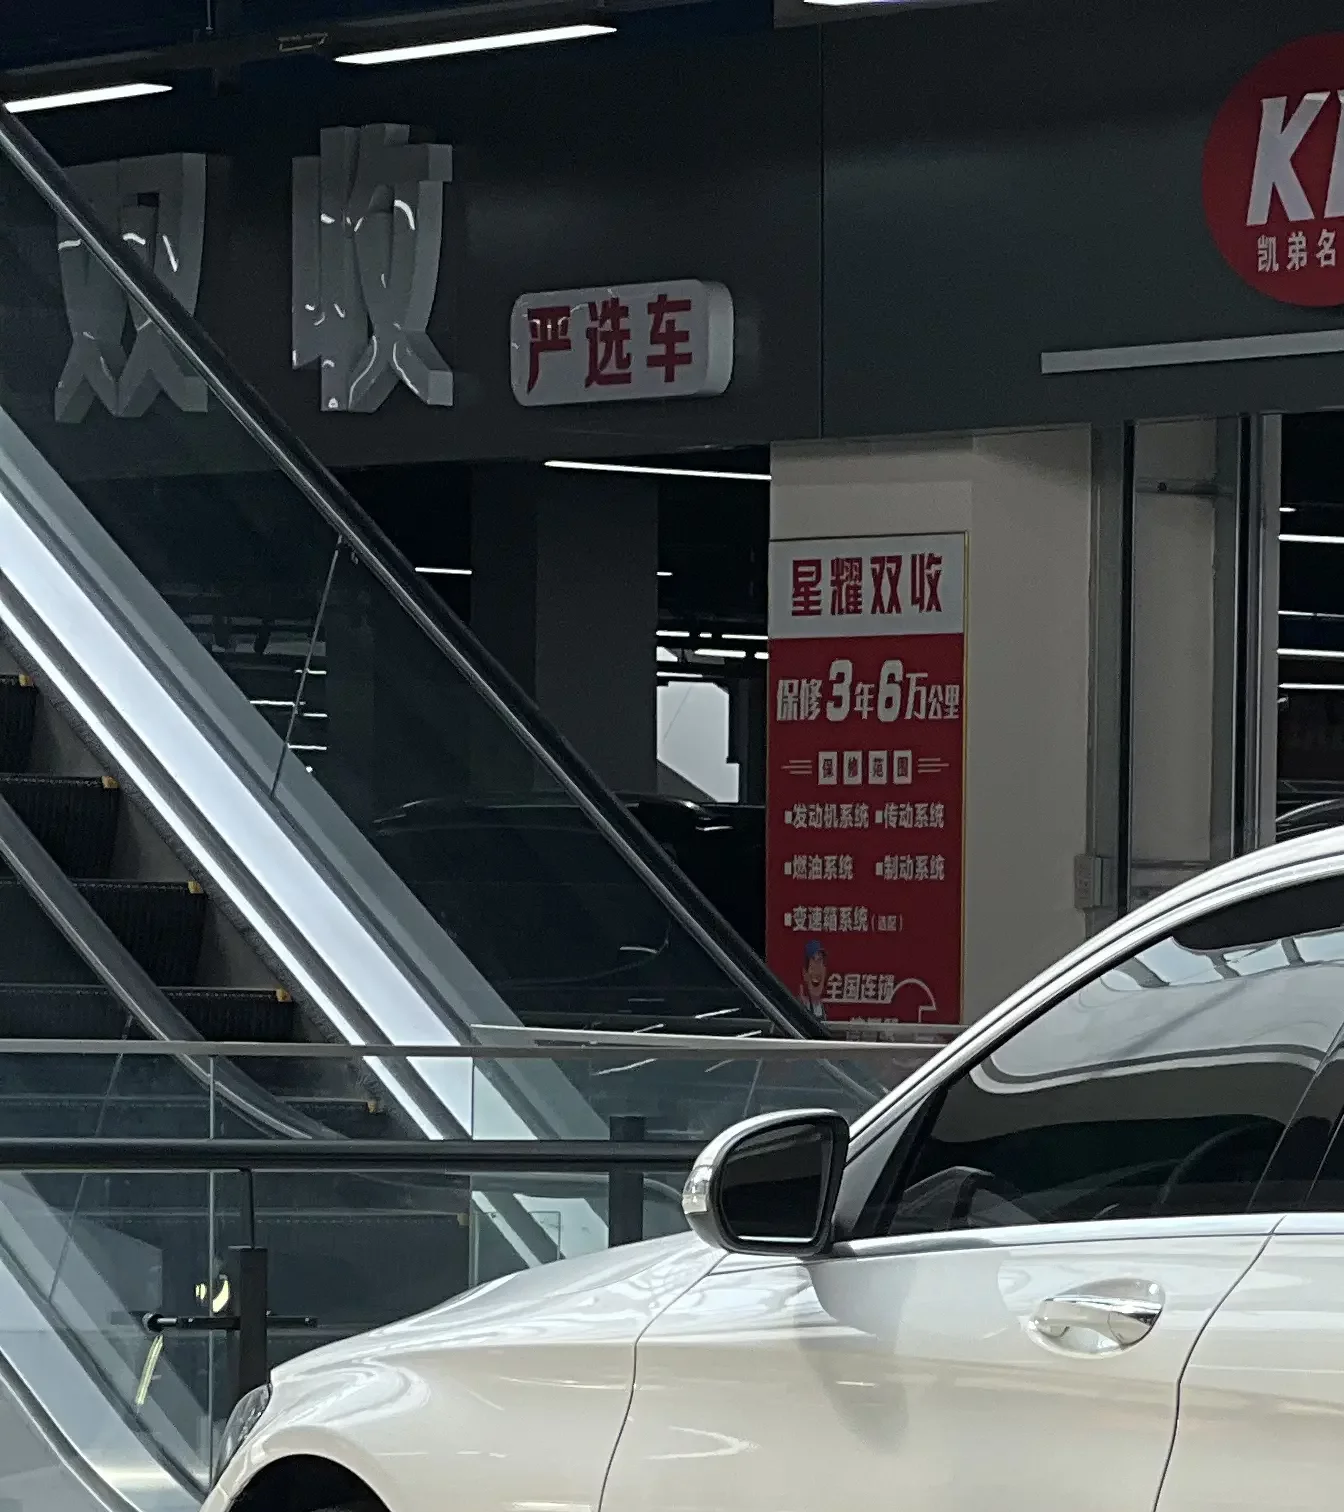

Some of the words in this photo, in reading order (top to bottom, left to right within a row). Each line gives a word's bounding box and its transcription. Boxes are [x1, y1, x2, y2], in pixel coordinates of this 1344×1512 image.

[526, 293, 693, 393] 严选车
[791, 552, 943, 617] 星耀双收
[775, 658, 961, 723] 保修3年6万公里
[792, 802, 870, 829] 发动机系统
[883, 802, 945, 829] 传动系统
[792, 854, 854, 881] 燃油系统
[883, 854, 946, 881] 制动系统
[792, 905, 869, 933] 变速箱系统
[826, 972, 896, 1002] 全国连锁
